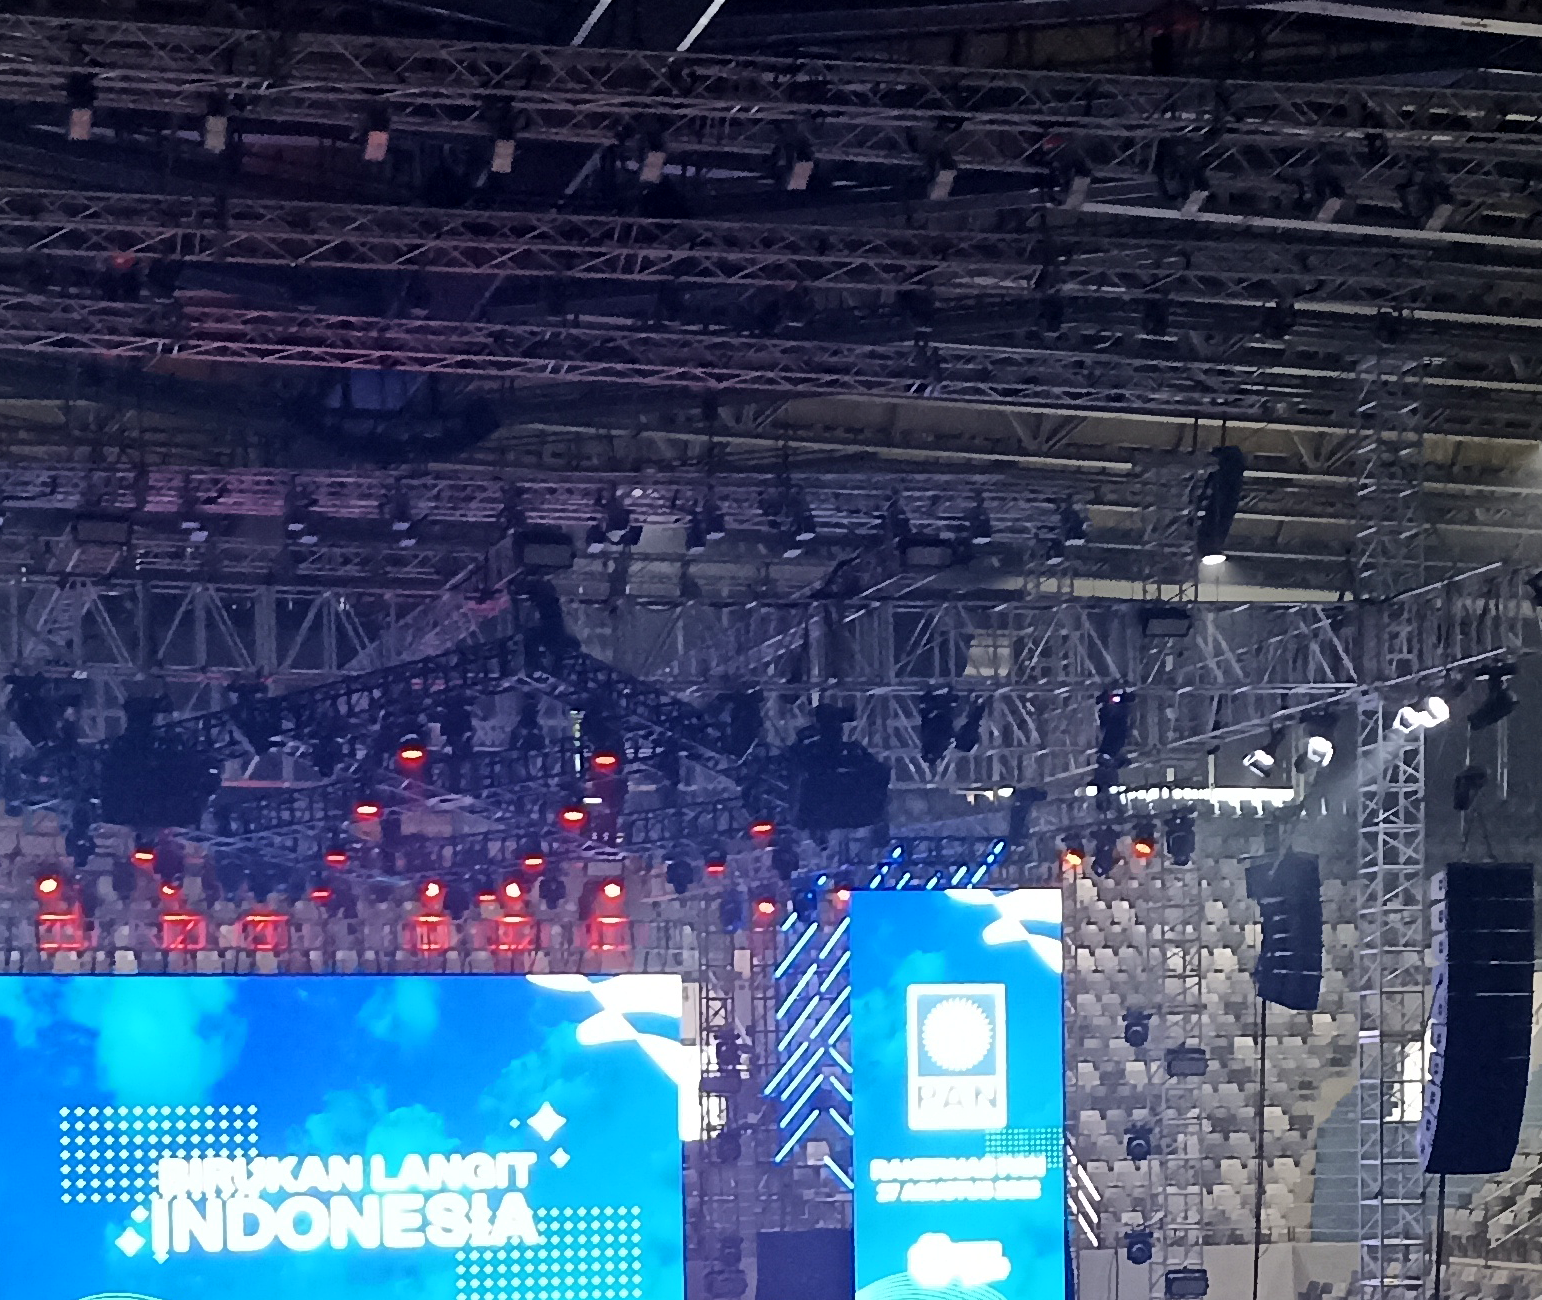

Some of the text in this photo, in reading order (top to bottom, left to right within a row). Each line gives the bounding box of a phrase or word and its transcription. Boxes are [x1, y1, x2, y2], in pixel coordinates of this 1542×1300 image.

[917, 1084, 998, 1111] PAN
[158, 1152, 537, 1196] BIRUKAN LANGIT
[151, 1192, 539, 1252] INDONESIA
